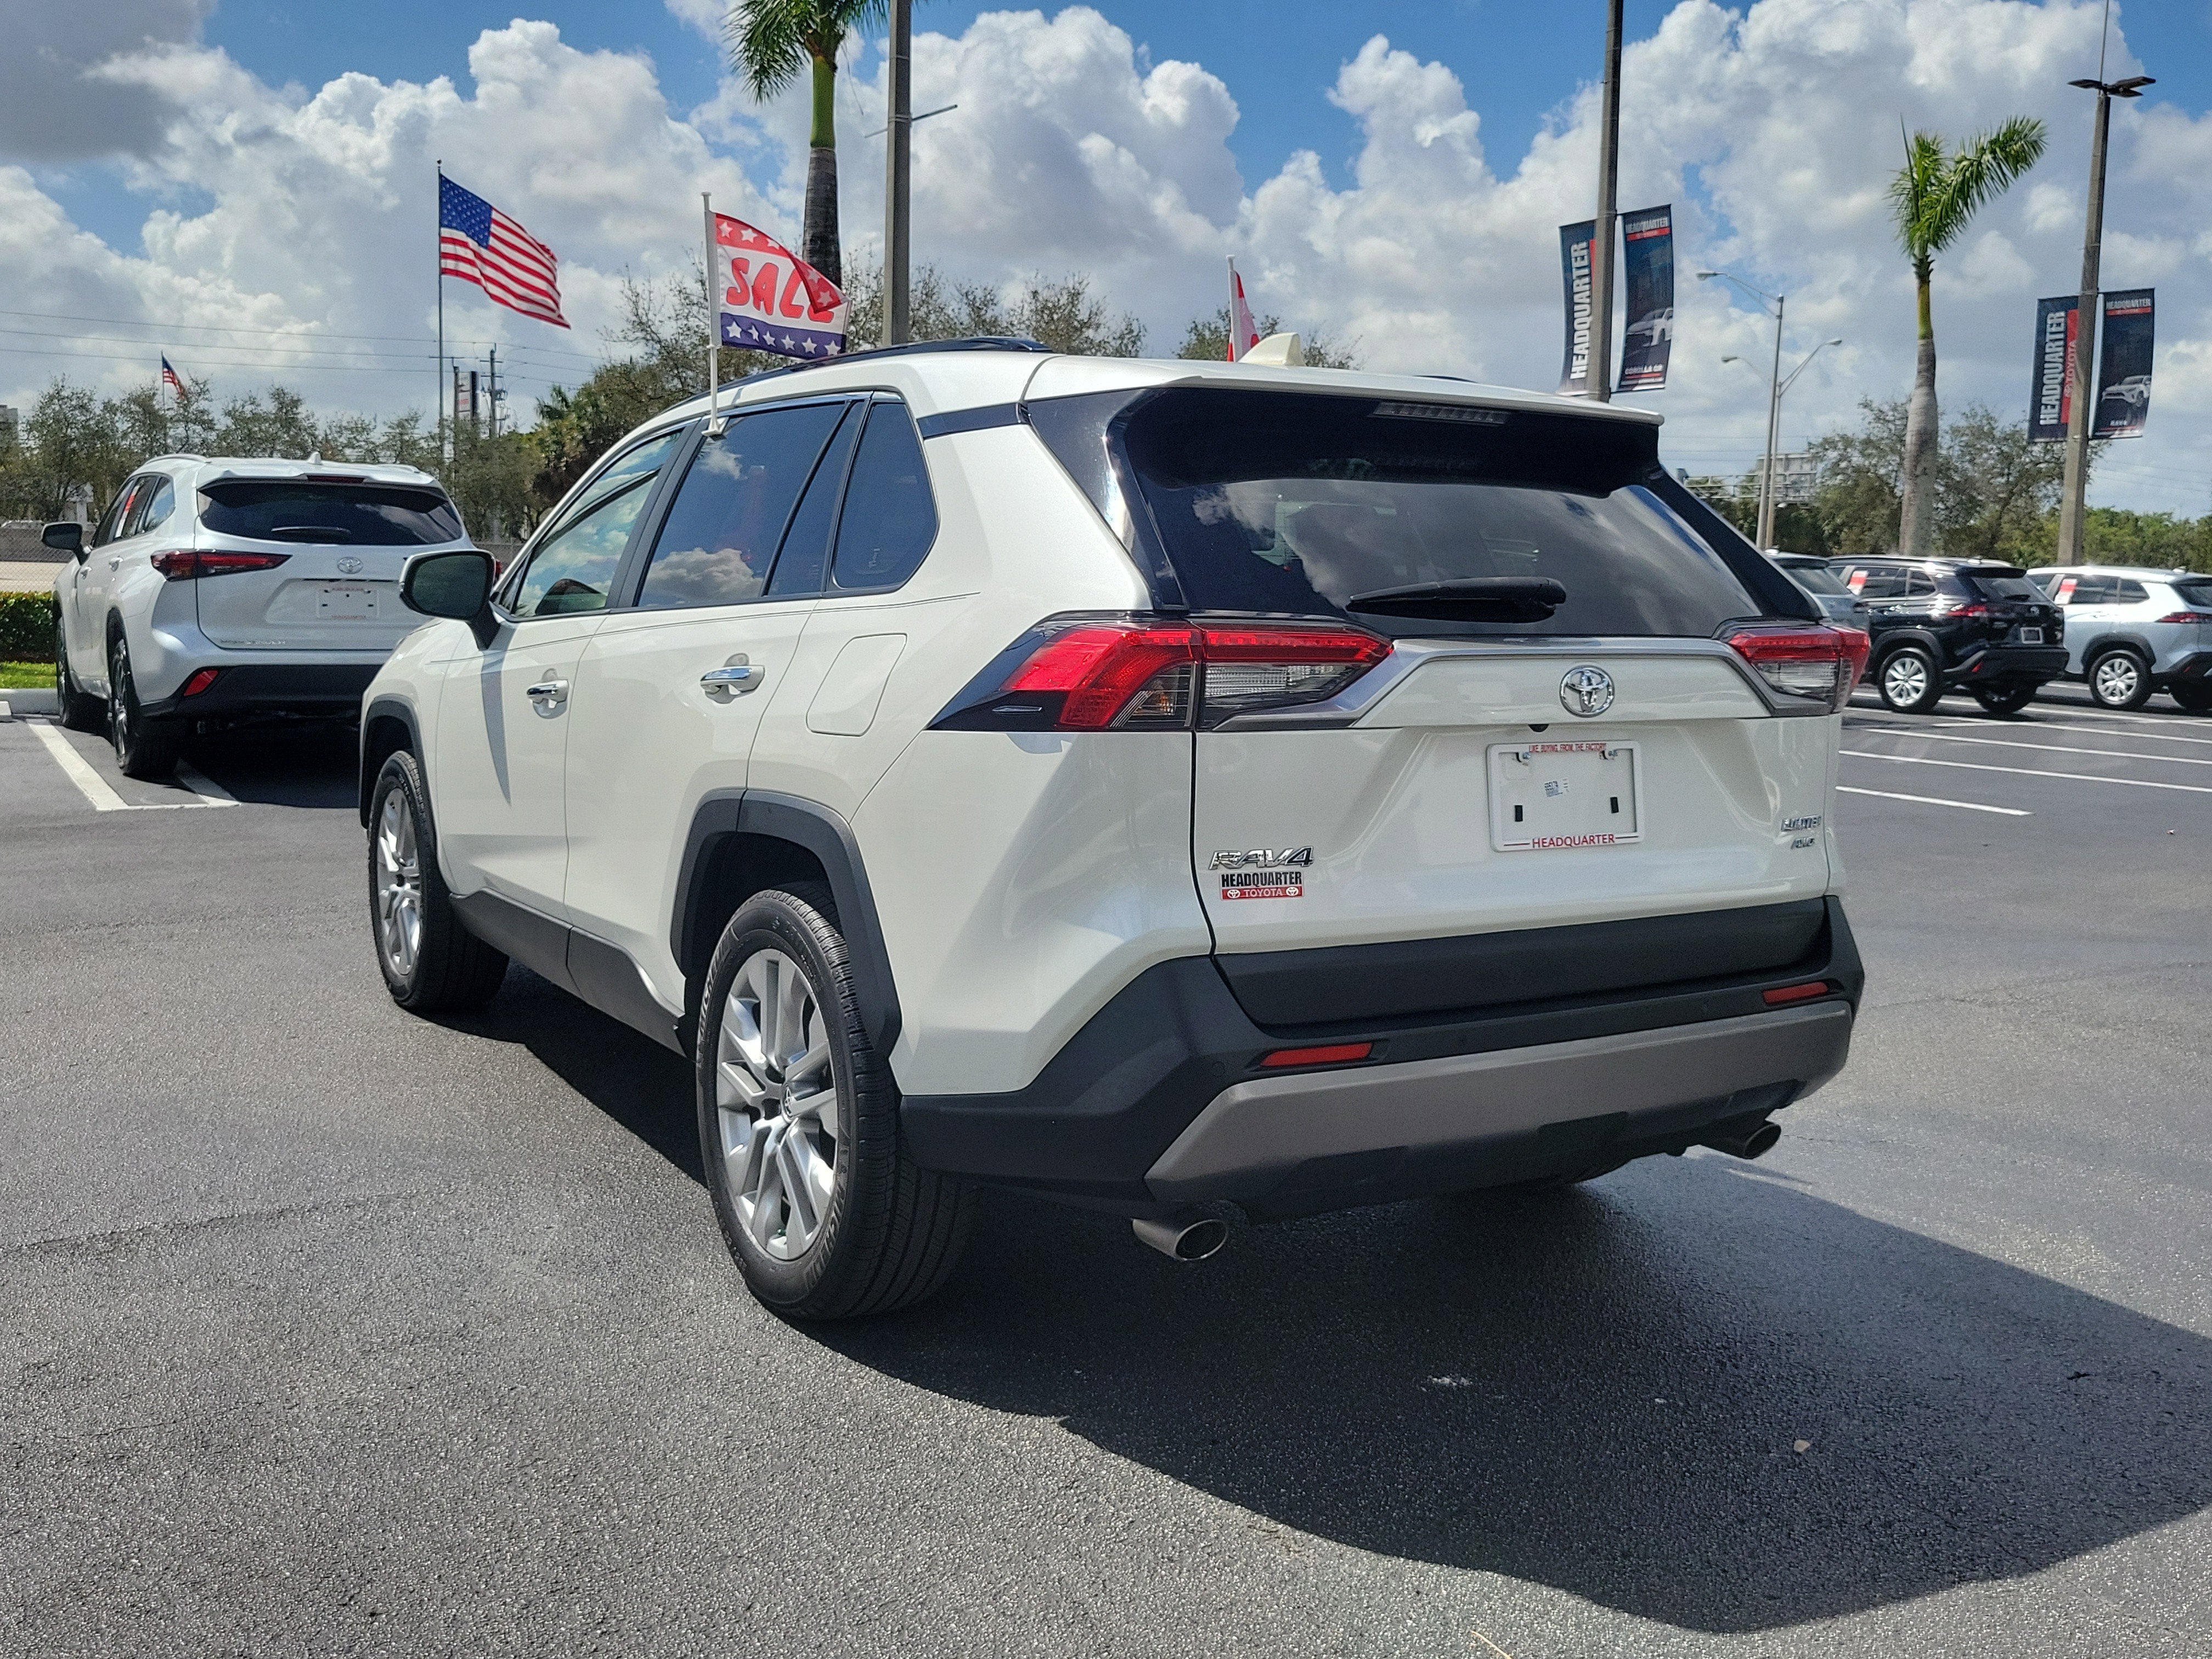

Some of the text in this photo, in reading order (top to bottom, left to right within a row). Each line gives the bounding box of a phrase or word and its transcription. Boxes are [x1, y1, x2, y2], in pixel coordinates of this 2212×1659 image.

[1570, 241, 1593, 379] HEADQUARTER
[2039, 311, 2066, 425] HEADQUARTER
[1532, 834, 1615, 849] HEADQUARTER
[1209, 845, 1314, 870] RAV4
[1221, 871, 1302, 888] HEADQUARTER
[1243, 888, 1283, 898] TOYOTA
[803, 1182, 846, 1290] MICHELIN
